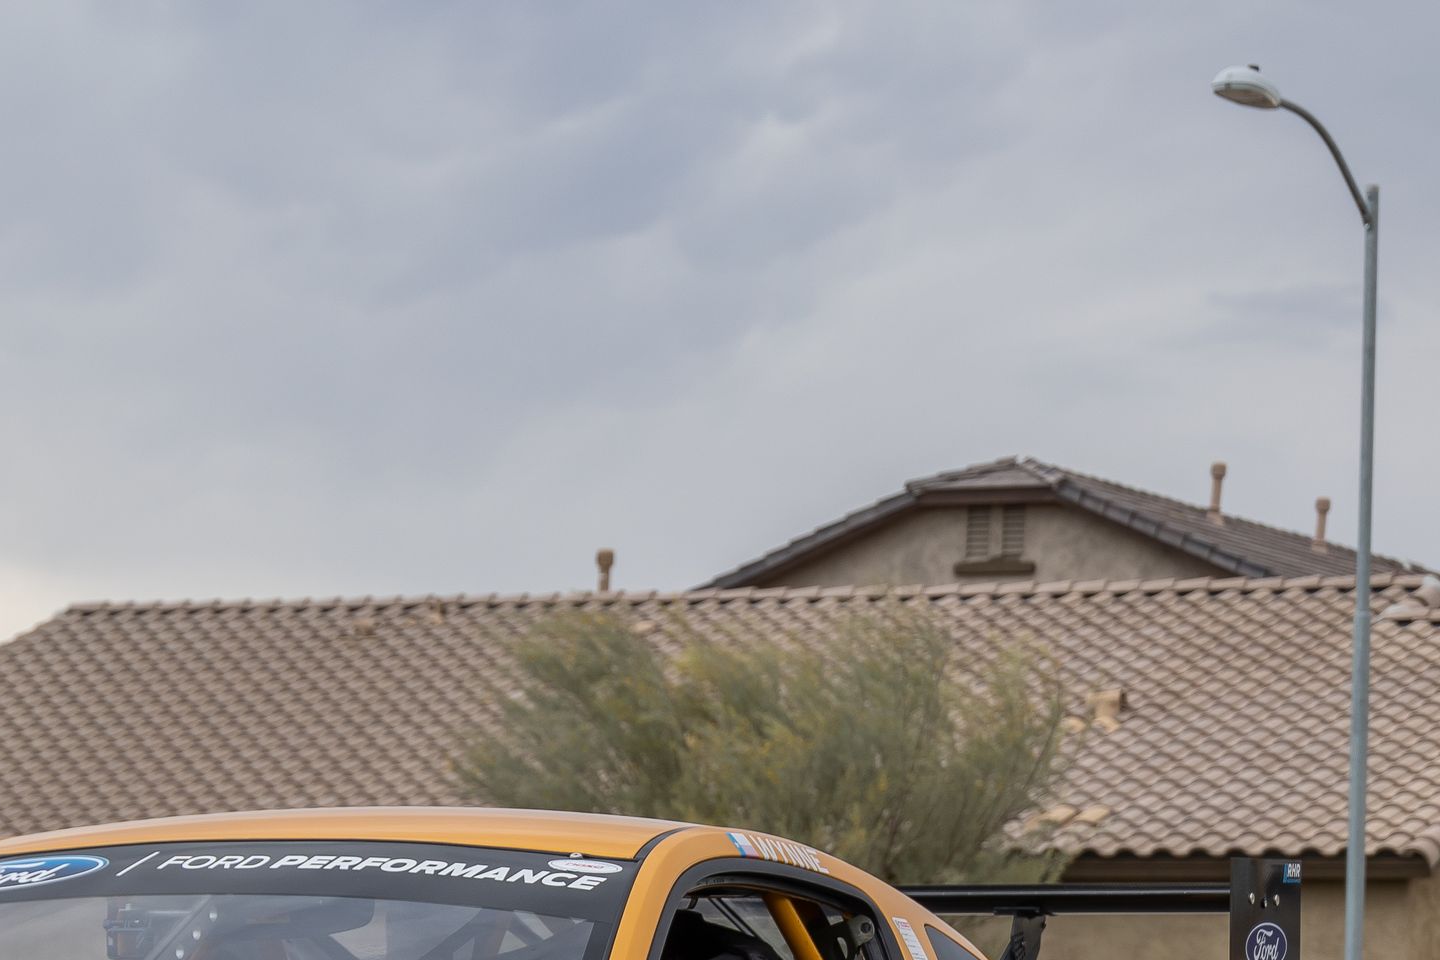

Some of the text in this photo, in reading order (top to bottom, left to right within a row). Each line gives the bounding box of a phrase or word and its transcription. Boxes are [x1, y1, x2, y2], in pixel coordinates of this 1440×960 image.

[157, 854, 608, 892] FORD PERFORMANCE
[748, 834, 830, 874] WYNNE
